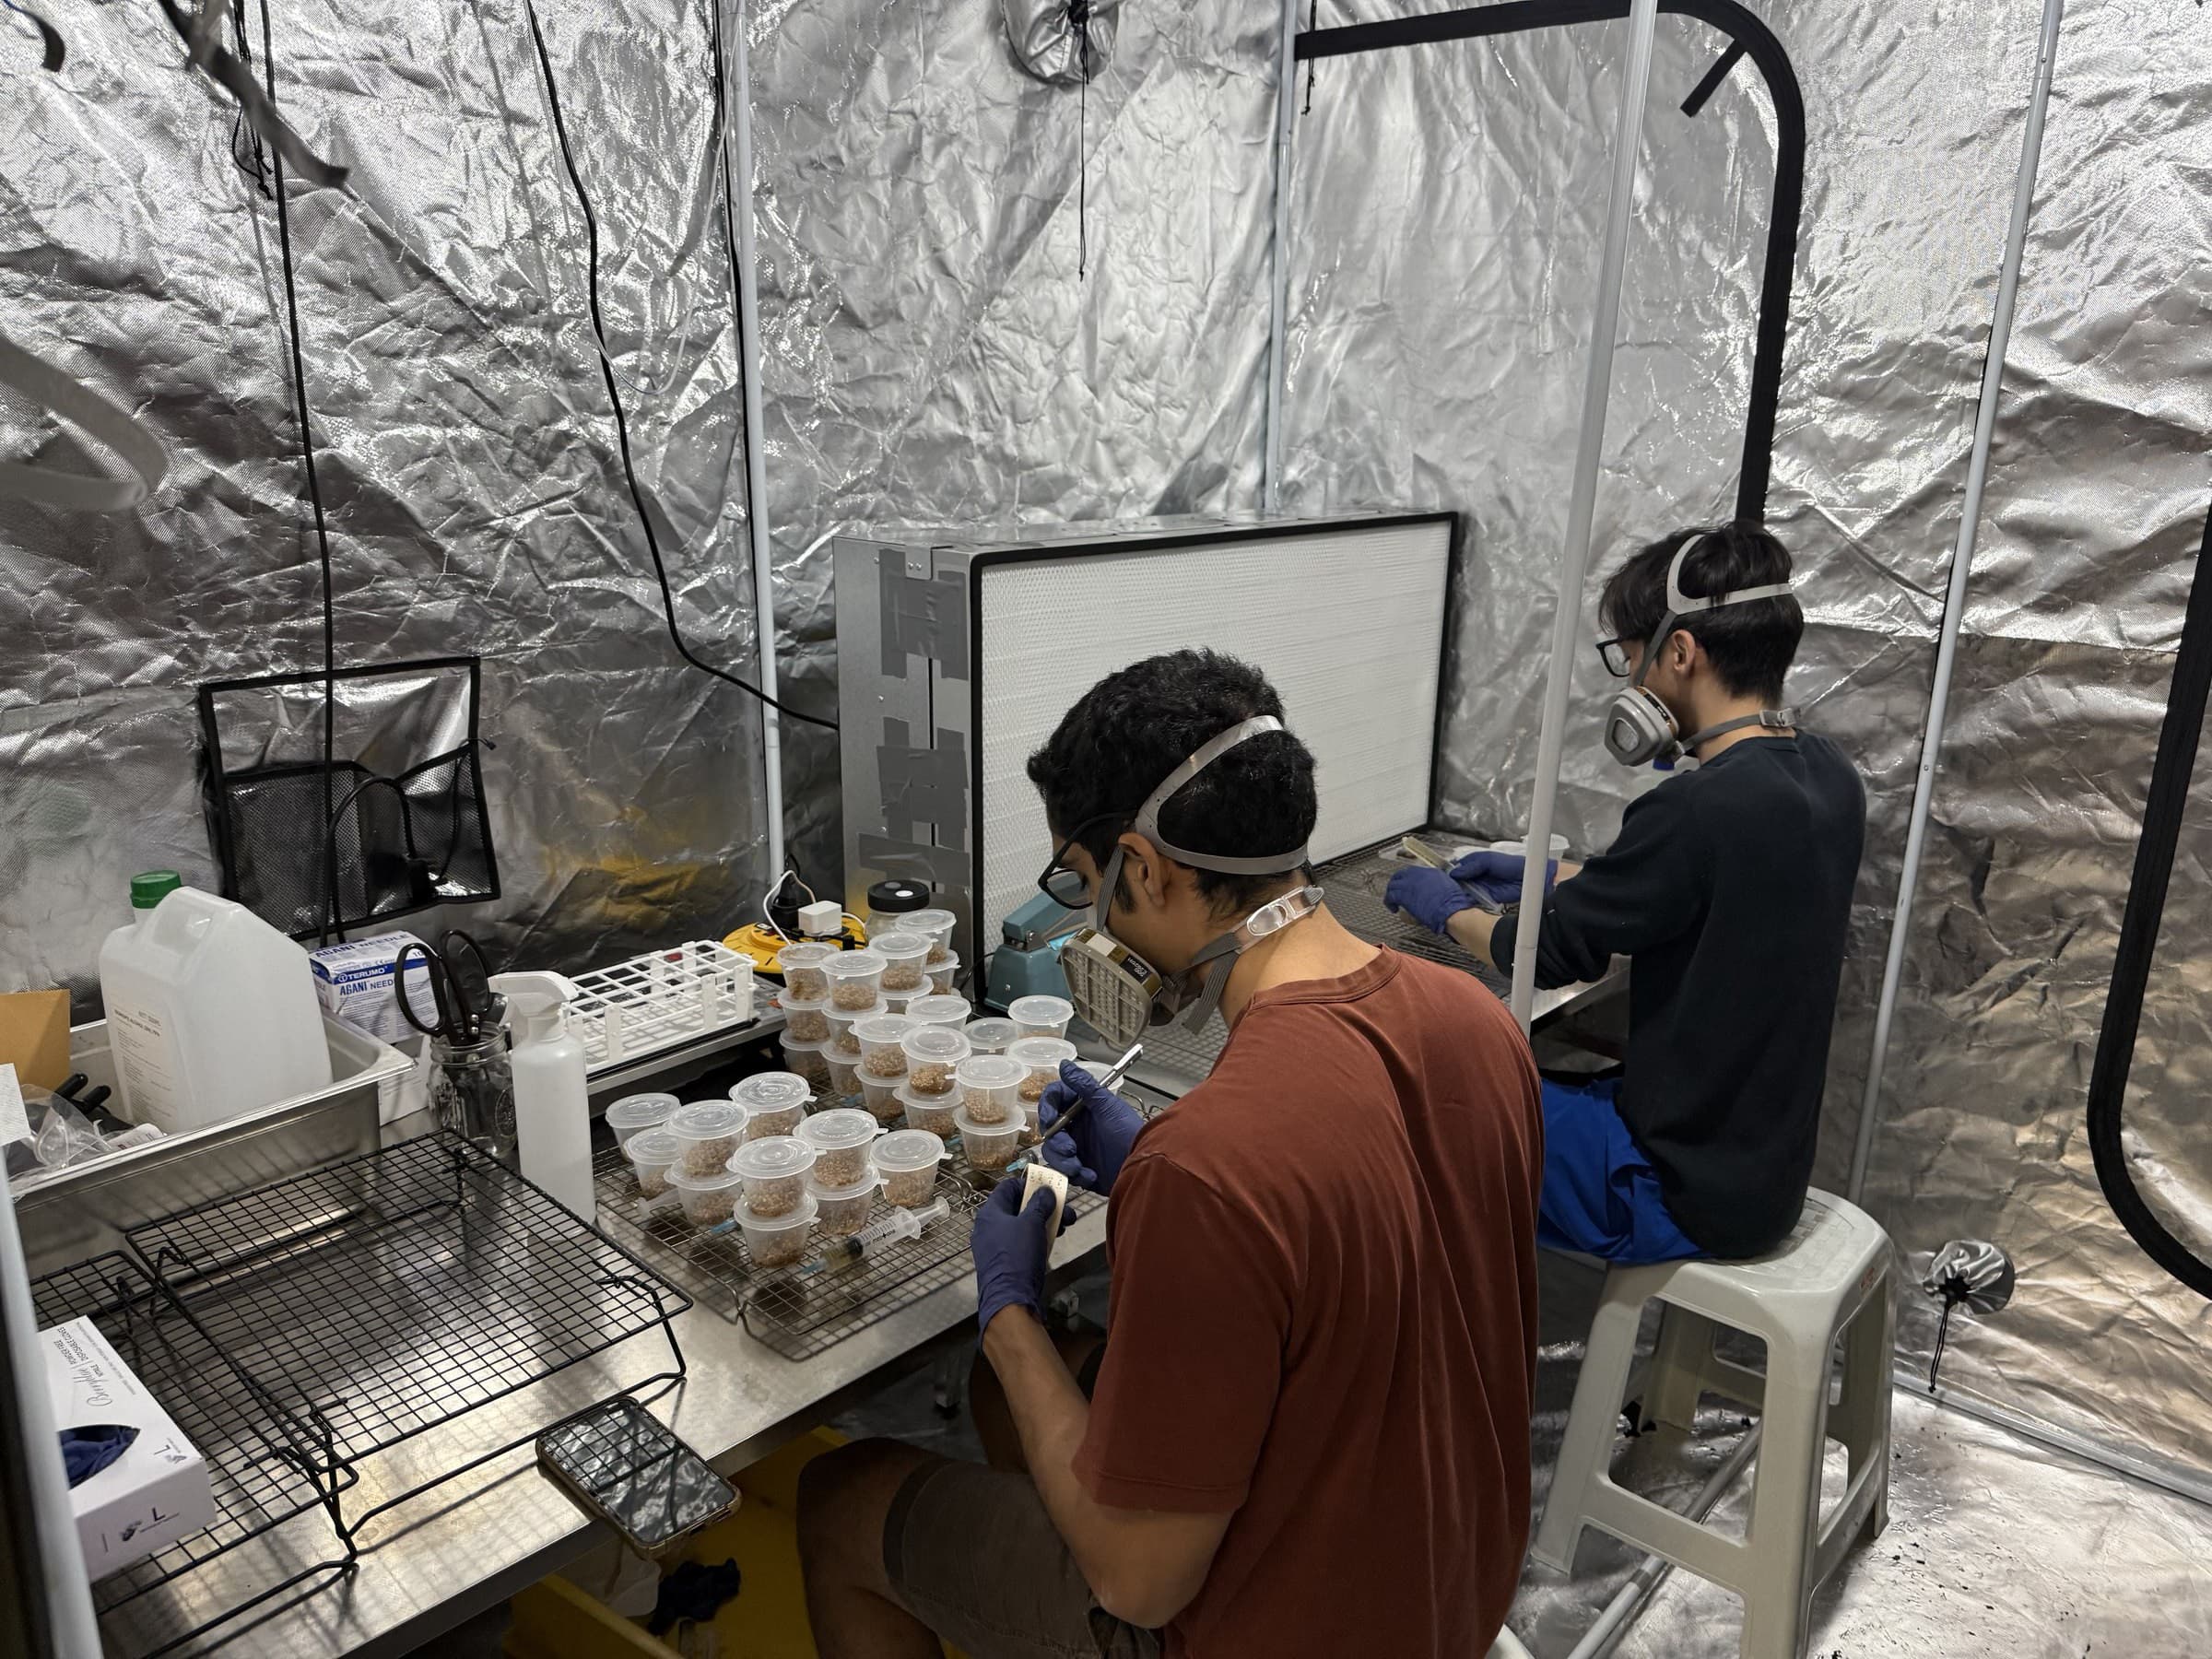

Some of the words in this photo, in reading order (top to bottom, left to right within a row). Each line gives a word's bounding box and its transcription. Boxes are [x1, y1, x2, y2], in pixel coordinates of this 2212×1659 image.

[315, 944, 355, 958] AGANI
[359, 934, 409, 948] NEEDLE
[348, 966, 385, 980] TERUMO
[339, 981, 368, 996] AGANI
[370, 979, 394, 990] NEED
[151, 1507, 166, 1522] L
